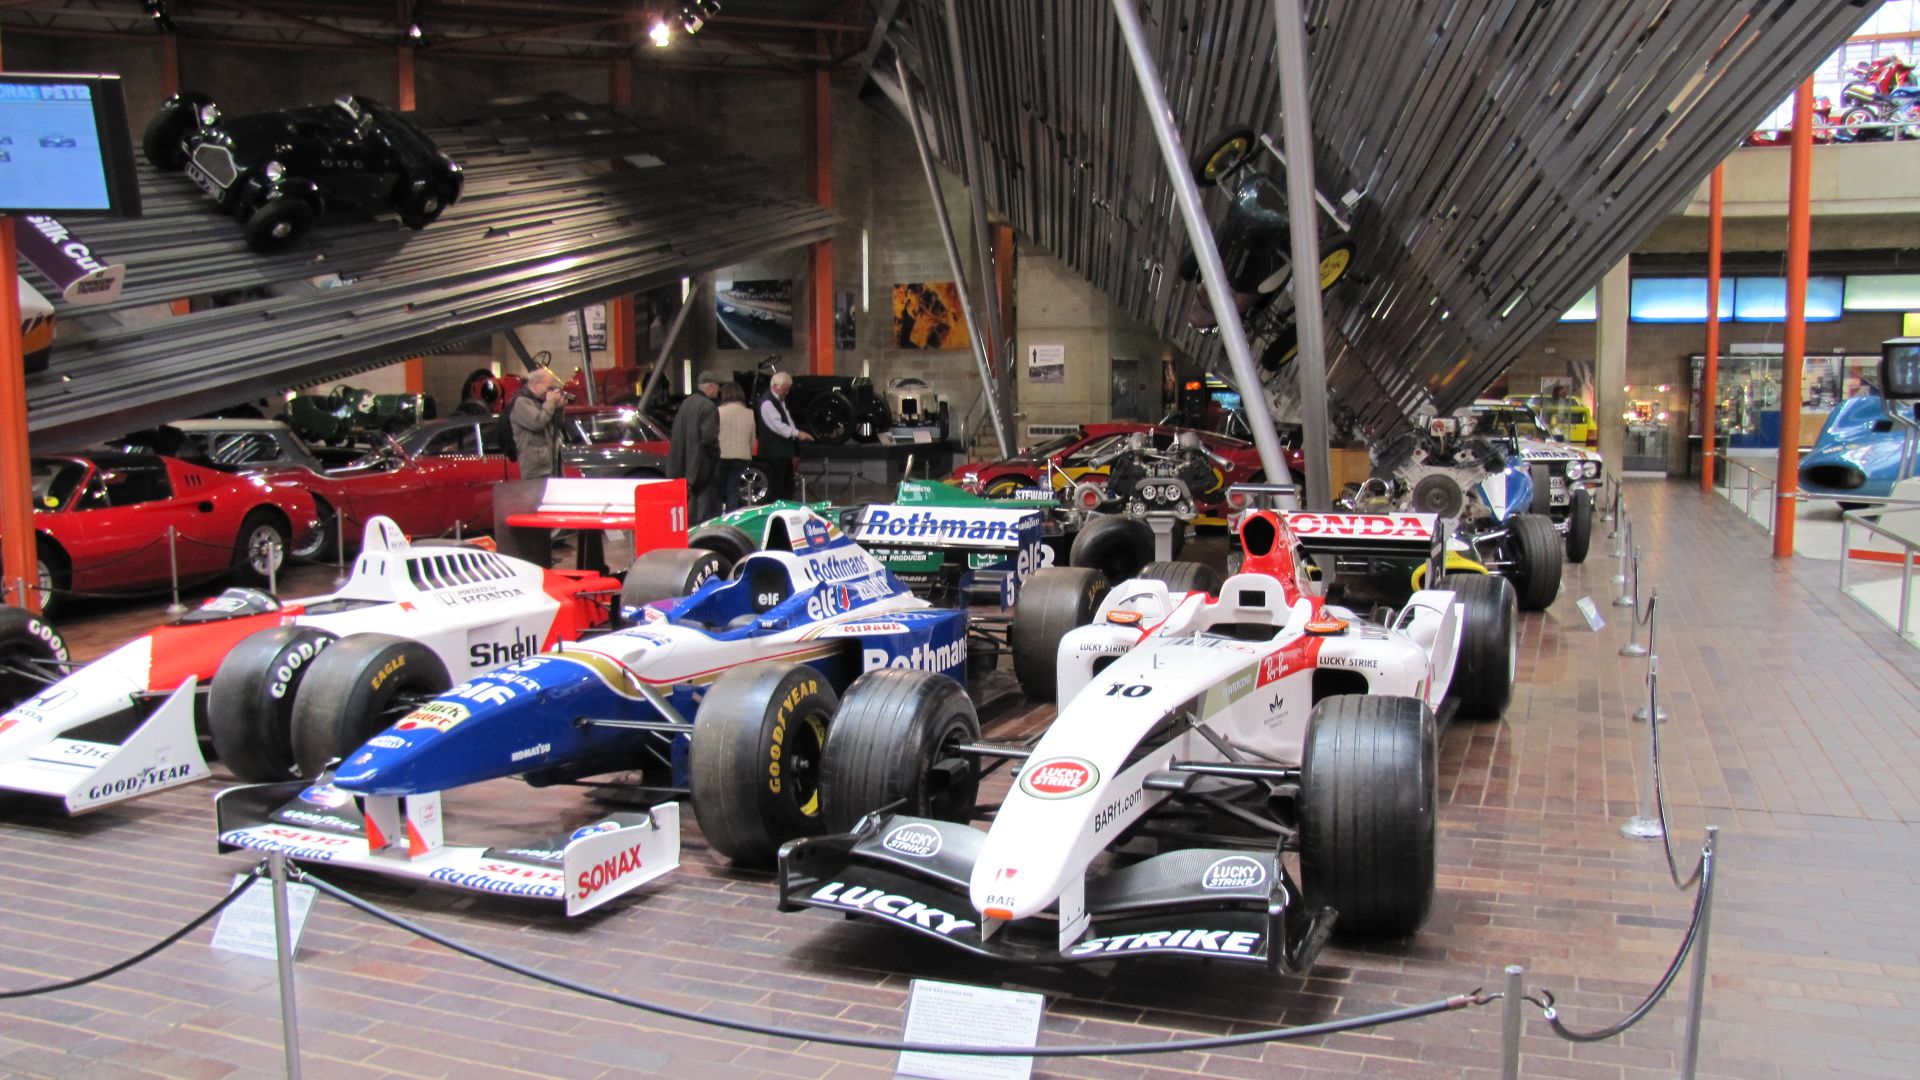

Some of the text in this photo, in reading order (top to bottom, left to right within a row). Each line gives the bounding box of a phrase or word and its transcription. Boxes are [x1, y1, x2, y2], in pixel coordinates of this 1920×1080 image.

[670, 505, 685, 532] 11
[866, 510, 1019, 541] Rothmans
[1230, 513, 1431, 537] ONDA
[809, 554, 870, 582] Rothmans
[889, 554, 927, 562] PRODUCER
[461, 588, 526, 604] HONDA
[758, 592, 780, 606] elf
[1006, 572, 1015, 607] 5
[807, 589, 836, 621] elf
[470, 634, 537, 668] Shell
[1080, 642, 1102, 652] LUCKY
[370, 654, 406, 690] EAGLE
[1319, 655, 1379, 669] LUCKY STRIKE
[1105, 682, 1153, 698] 10
[769, 679, 818, 794] GOODYEAR
[89, 764, 191, 800] GOODYEAR
[1032, 776, 1081, 789] STRIKE
[1040, 767, 1086, 780] LUCKY
[1094, 788, 1142, 834] BARf1.com
[888, 840, 931, 855] STRIKE
[896, 829, 937, 848] LUCKY
[430, 866, 559, 898] Rothmans
[577, 843, 642, 900] SONAX
[1208, 877, 1256, 888] STRIKE
[1212, 865, 1258, 879] LUCKY
[986, 894, 1015, 907] BAR
[812, 881, 1260, 955] LUCKY STRIKE
